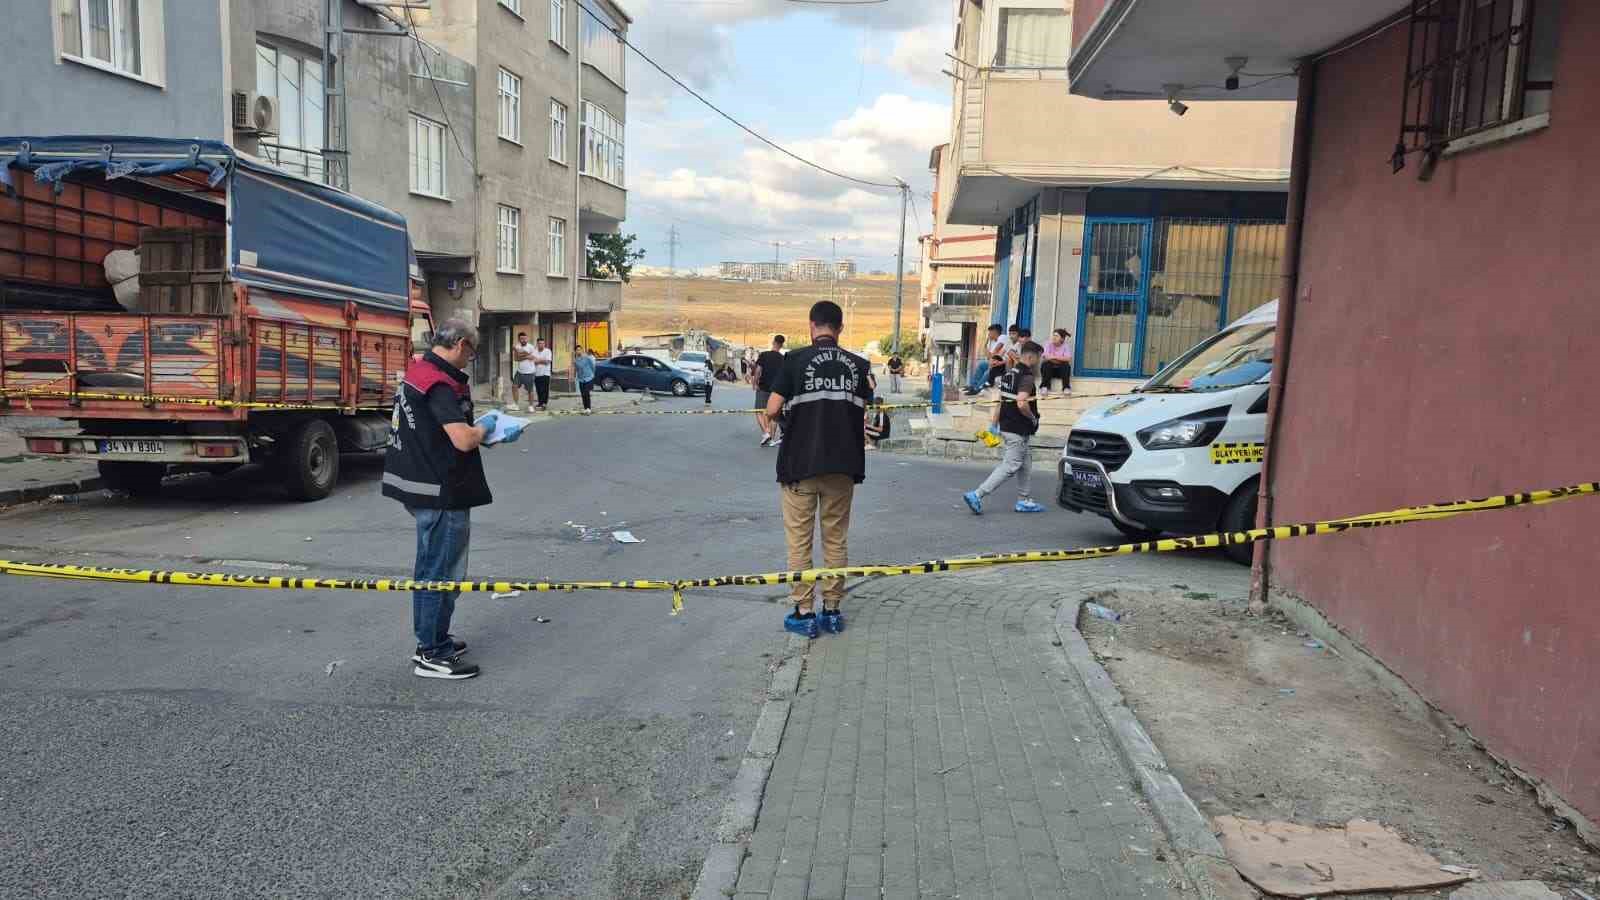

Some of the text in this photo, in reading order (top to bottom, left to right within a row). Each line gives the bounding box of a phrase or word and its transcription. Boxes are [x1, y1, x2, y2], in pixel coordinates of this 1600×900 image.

[804, 364, 816, 391] OLAY
[814, 374, 852, 391] POLİS
[1215, 448, 1232, 458] OLAY
